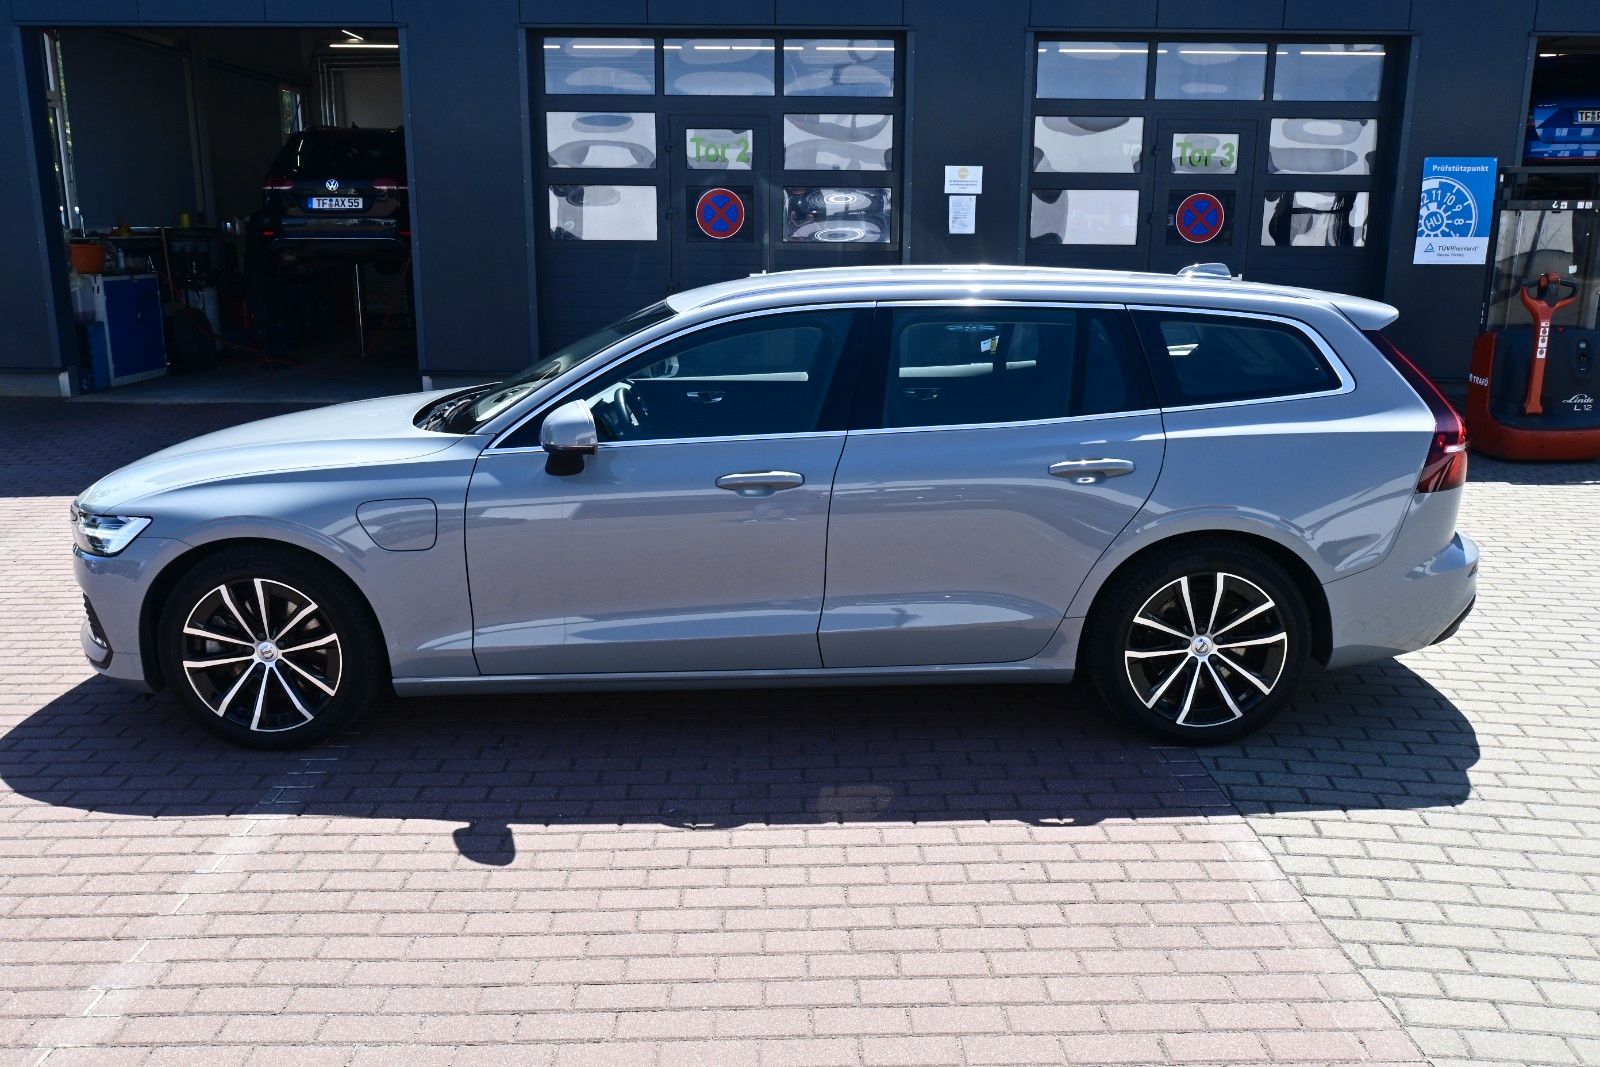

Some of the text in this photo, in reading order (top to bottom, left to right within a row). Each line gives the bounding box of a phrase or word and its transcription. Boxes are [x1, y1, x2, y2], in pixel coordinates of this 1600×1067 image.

[1579, 111, 1591, 121] TF
[690, 136, 750, 163] Tor 2
[1176, 142, 1235, 168] Tor 3
[1432, 165, 1489, 173] Prüfstützpunkt
[1431, 189, 1442, 201] 11
[1443, 192, 1456, 206] 10
[316, 198, 360, 208] TF AX 55
[1452, 204, 1463, 212] 9
[1425, 214, 1442, 230] HU
[1453, 218, 1464, 226] 8
[1562, 393, 1594, 404] Linde
